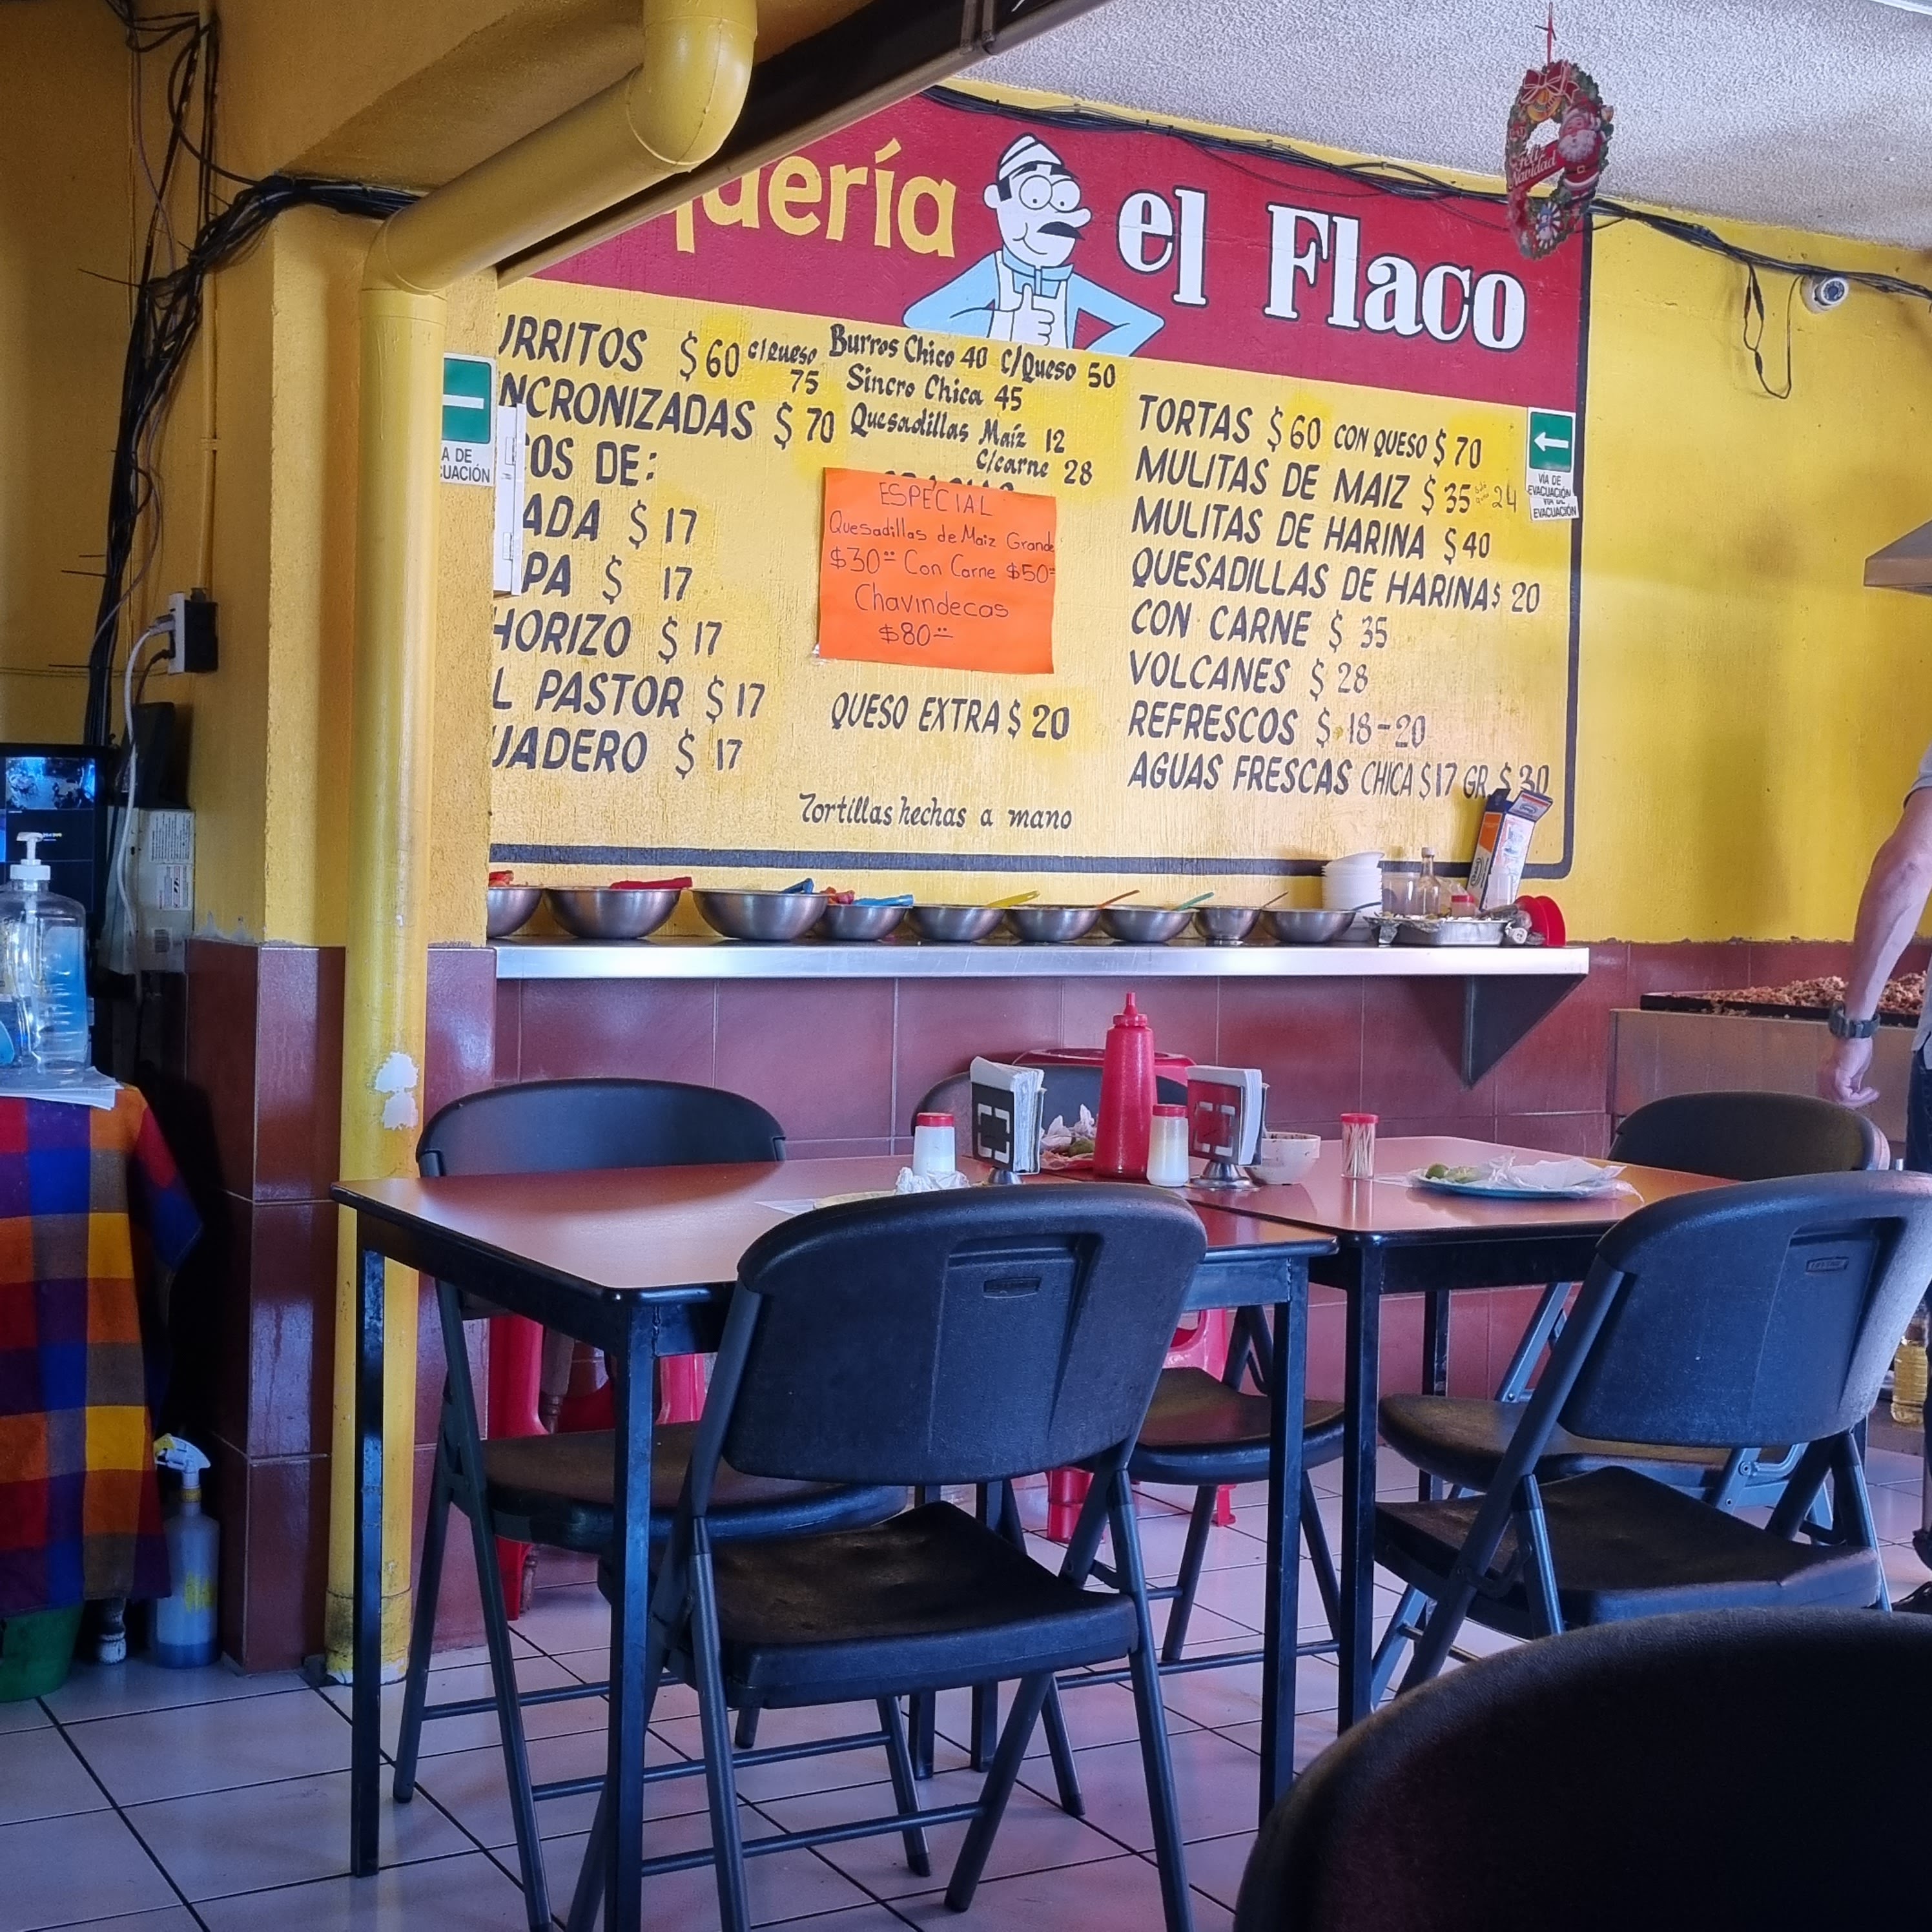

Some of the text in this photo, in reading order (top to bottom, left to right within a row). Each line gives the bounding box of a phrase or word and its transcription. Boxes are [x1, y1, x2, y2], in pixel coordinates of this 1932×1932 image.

[1509, 150, 1556, 188] Navidad
[1516, 147, 1545, 172] Feliz
[1117, 186, 1208, 306] el
[1264, 202, 1526, 352] Flaco
[829, 324, 899, 357] Burros
[905, 335, 954, 367] Chico
[960, 347, 987, 369] 40
[1089, 363, 1115, 388] 50
[790, 369, 819, 395] 75
[847, 364, 1023, 411] Sincro Chica 45
[499, 373, 755, 440] NCRONIZADAS
[851, 402, 1064, 453] Quesadillas Maíz 12
[1139, 395, 1253, 443] TORTAS
[1335, 424, 1369, 451] CON
[1374, 429, 1427, 458] QUESO
[440, 464, 489, 482] UACIÓN
[455, 448, 472, 463] DE
[525, 433, 657, 486] OS DE:
[1064, 460, 1092, 486] 28
[1136, 446, 1269, 495] MULITAS
[1282, 462, 1320, 500] DE
[1333, 468, 1410, 509] MAIZ
[1528, 485, 1571, 499] EVACUACIÓN
[1538, 472, 1561, 486] VÍA DE
[830, 511, 1055, 553] Quesadillas de Maiz Grande
[1132, 496, 1262, 544] MULITAS
[1277, 511, 1314, 548] DE
[1324, 516, 1423, 559] HARINA
[904, 549, 942, 575] Con
[951, 553, 996, 579] Carne
[1133, 548, 1329, 598] QUESADILLAS
[1341, 566, 1377, 602] DE
[1386, 571, 1487, 611] HARINA
[855, 581, 1009, 618] Chavindecas
[1132, 599, 1191, 638] CON
[1210, 606, 1311, 646] CARNE
[535, 670, 683, 718] PASTOR
[1130, 650, 1290, 694] VOLCANES
[832, 692, 908, 729] QUESO
[919, 697, 999, 734] EXTRA
[1128, 701, 1298, 745] REFRESCOS
[1127, 751, 1223, 790] AGUAS
[1233, 755, 1352, 795] FRESCAS
[1362, 761, 1412, 796] CHICA
[799, 793, 1071, 829] Tortillas hechas a mano
